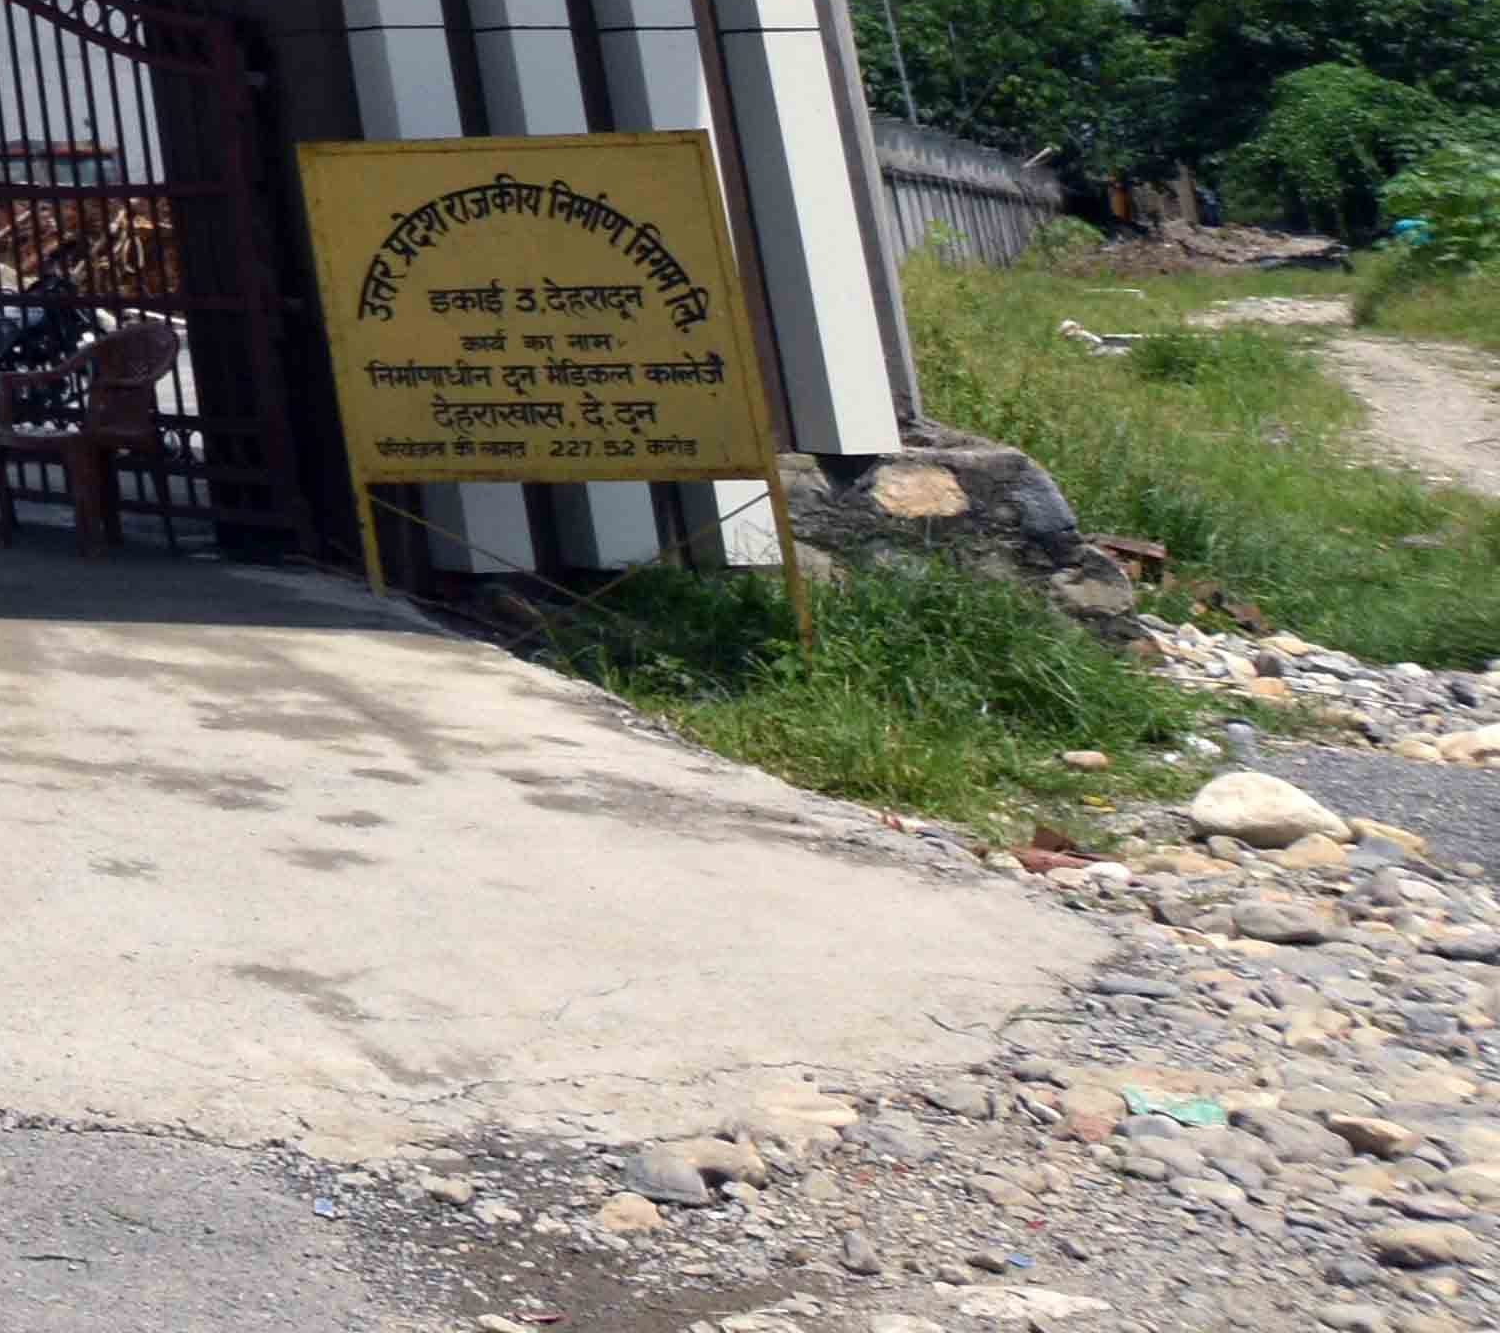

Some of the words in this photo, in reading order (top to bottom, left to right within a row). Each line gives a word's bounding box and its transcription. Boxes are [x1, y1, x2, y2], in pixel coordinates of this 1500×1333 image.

[381, 201, 448, 265] प्रदेश
[445, 173, 545, 223] राजकीय
[548, 179, 632, 248] निर्माण
[623, 222, 690, 292] निगम
[522, 334, 554, 352] का
[502, 364, 537, 396] दून
[543, 358, 634, 388] मेडिकल
